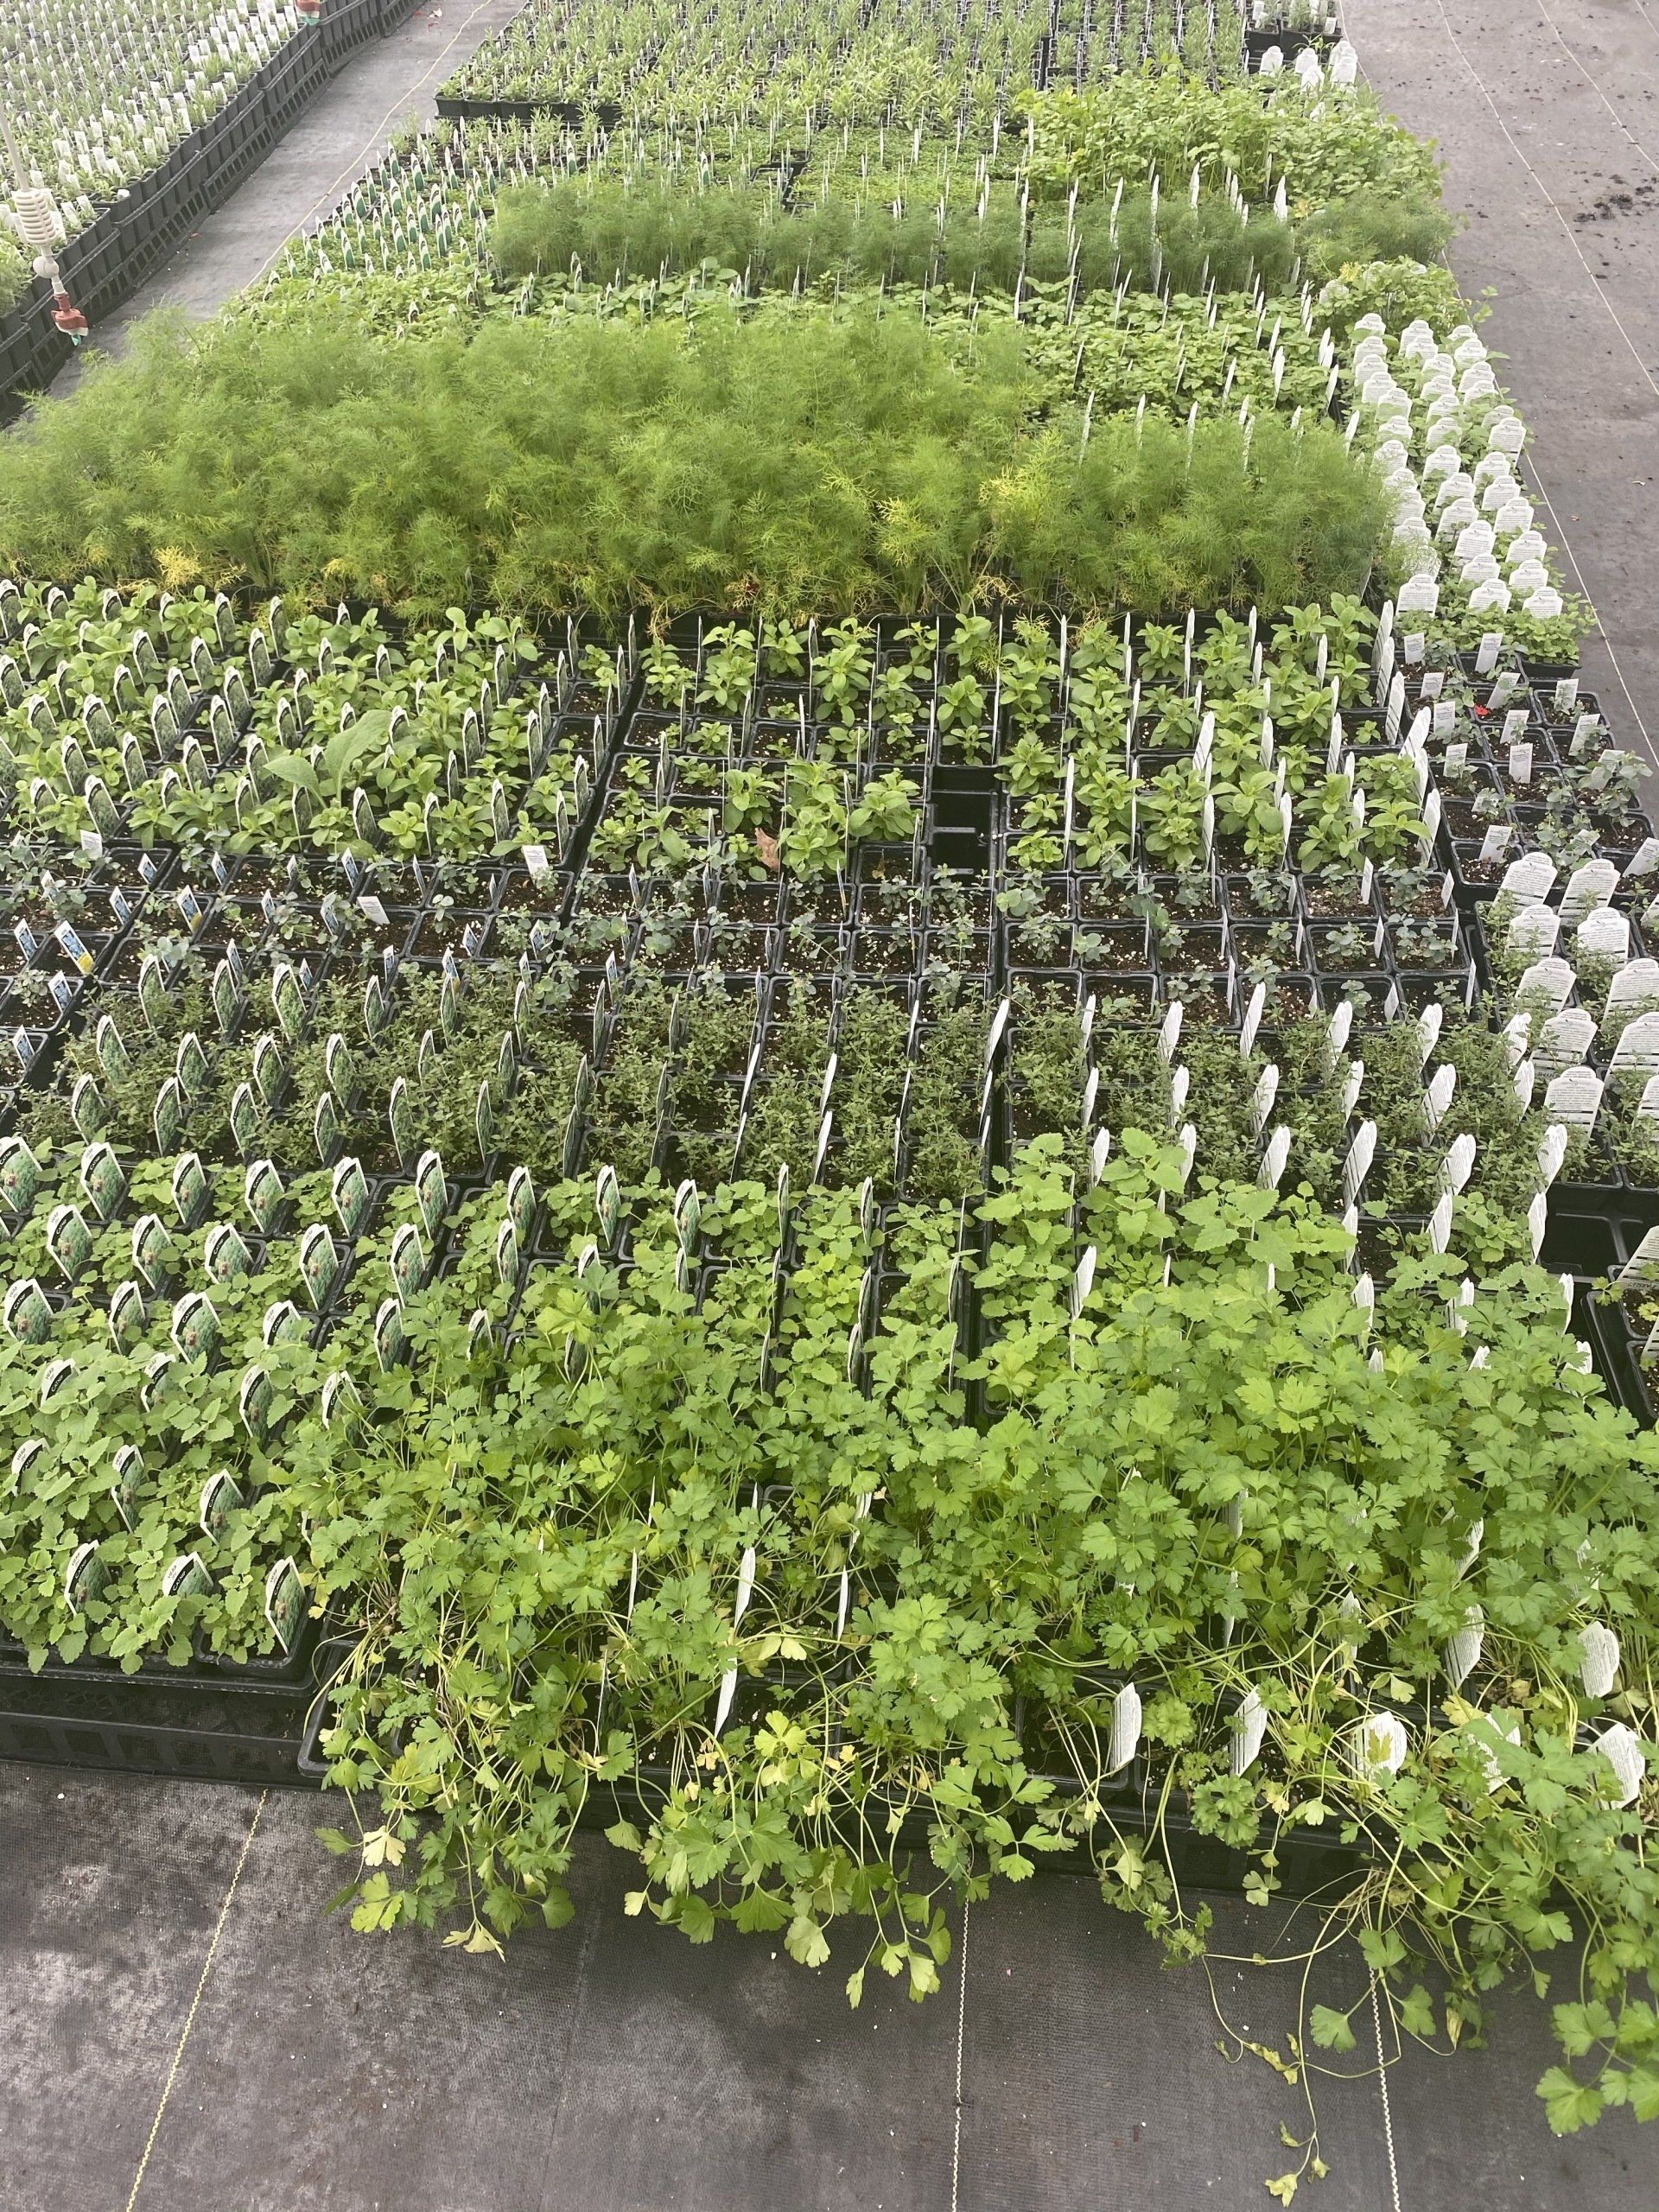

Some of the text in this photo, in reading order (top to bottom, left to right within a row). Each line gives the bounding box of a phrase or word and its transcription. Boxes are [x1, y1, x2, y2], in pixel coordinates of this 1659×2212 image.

[90, 1156, 100, 1171] CATNIP
[56, 1218, 67, 1235] CATNIP
[140, 1229, 149, 1245] CATNIP
[308, 1238, 319, 1253] CATNIP
[213, 1238, 224, 1255] CATNIP
[14, 1294, 26, 1310] CATNIP
[182, 1306, 194, 1324] CATNIP
[272, 1316, 283, 1332] CATNIP
[52, 1375, 63, 1392] CATNIP
[249, 1381, 258, 1397] CATNIP
[209, 1487, 219, 1508] CATNIP
[75, 1559, 87, 1580] CATNIP
[173, 1571, 186, 1592] CATNIP
[274, 1574, 284, 1596] CATNIP
